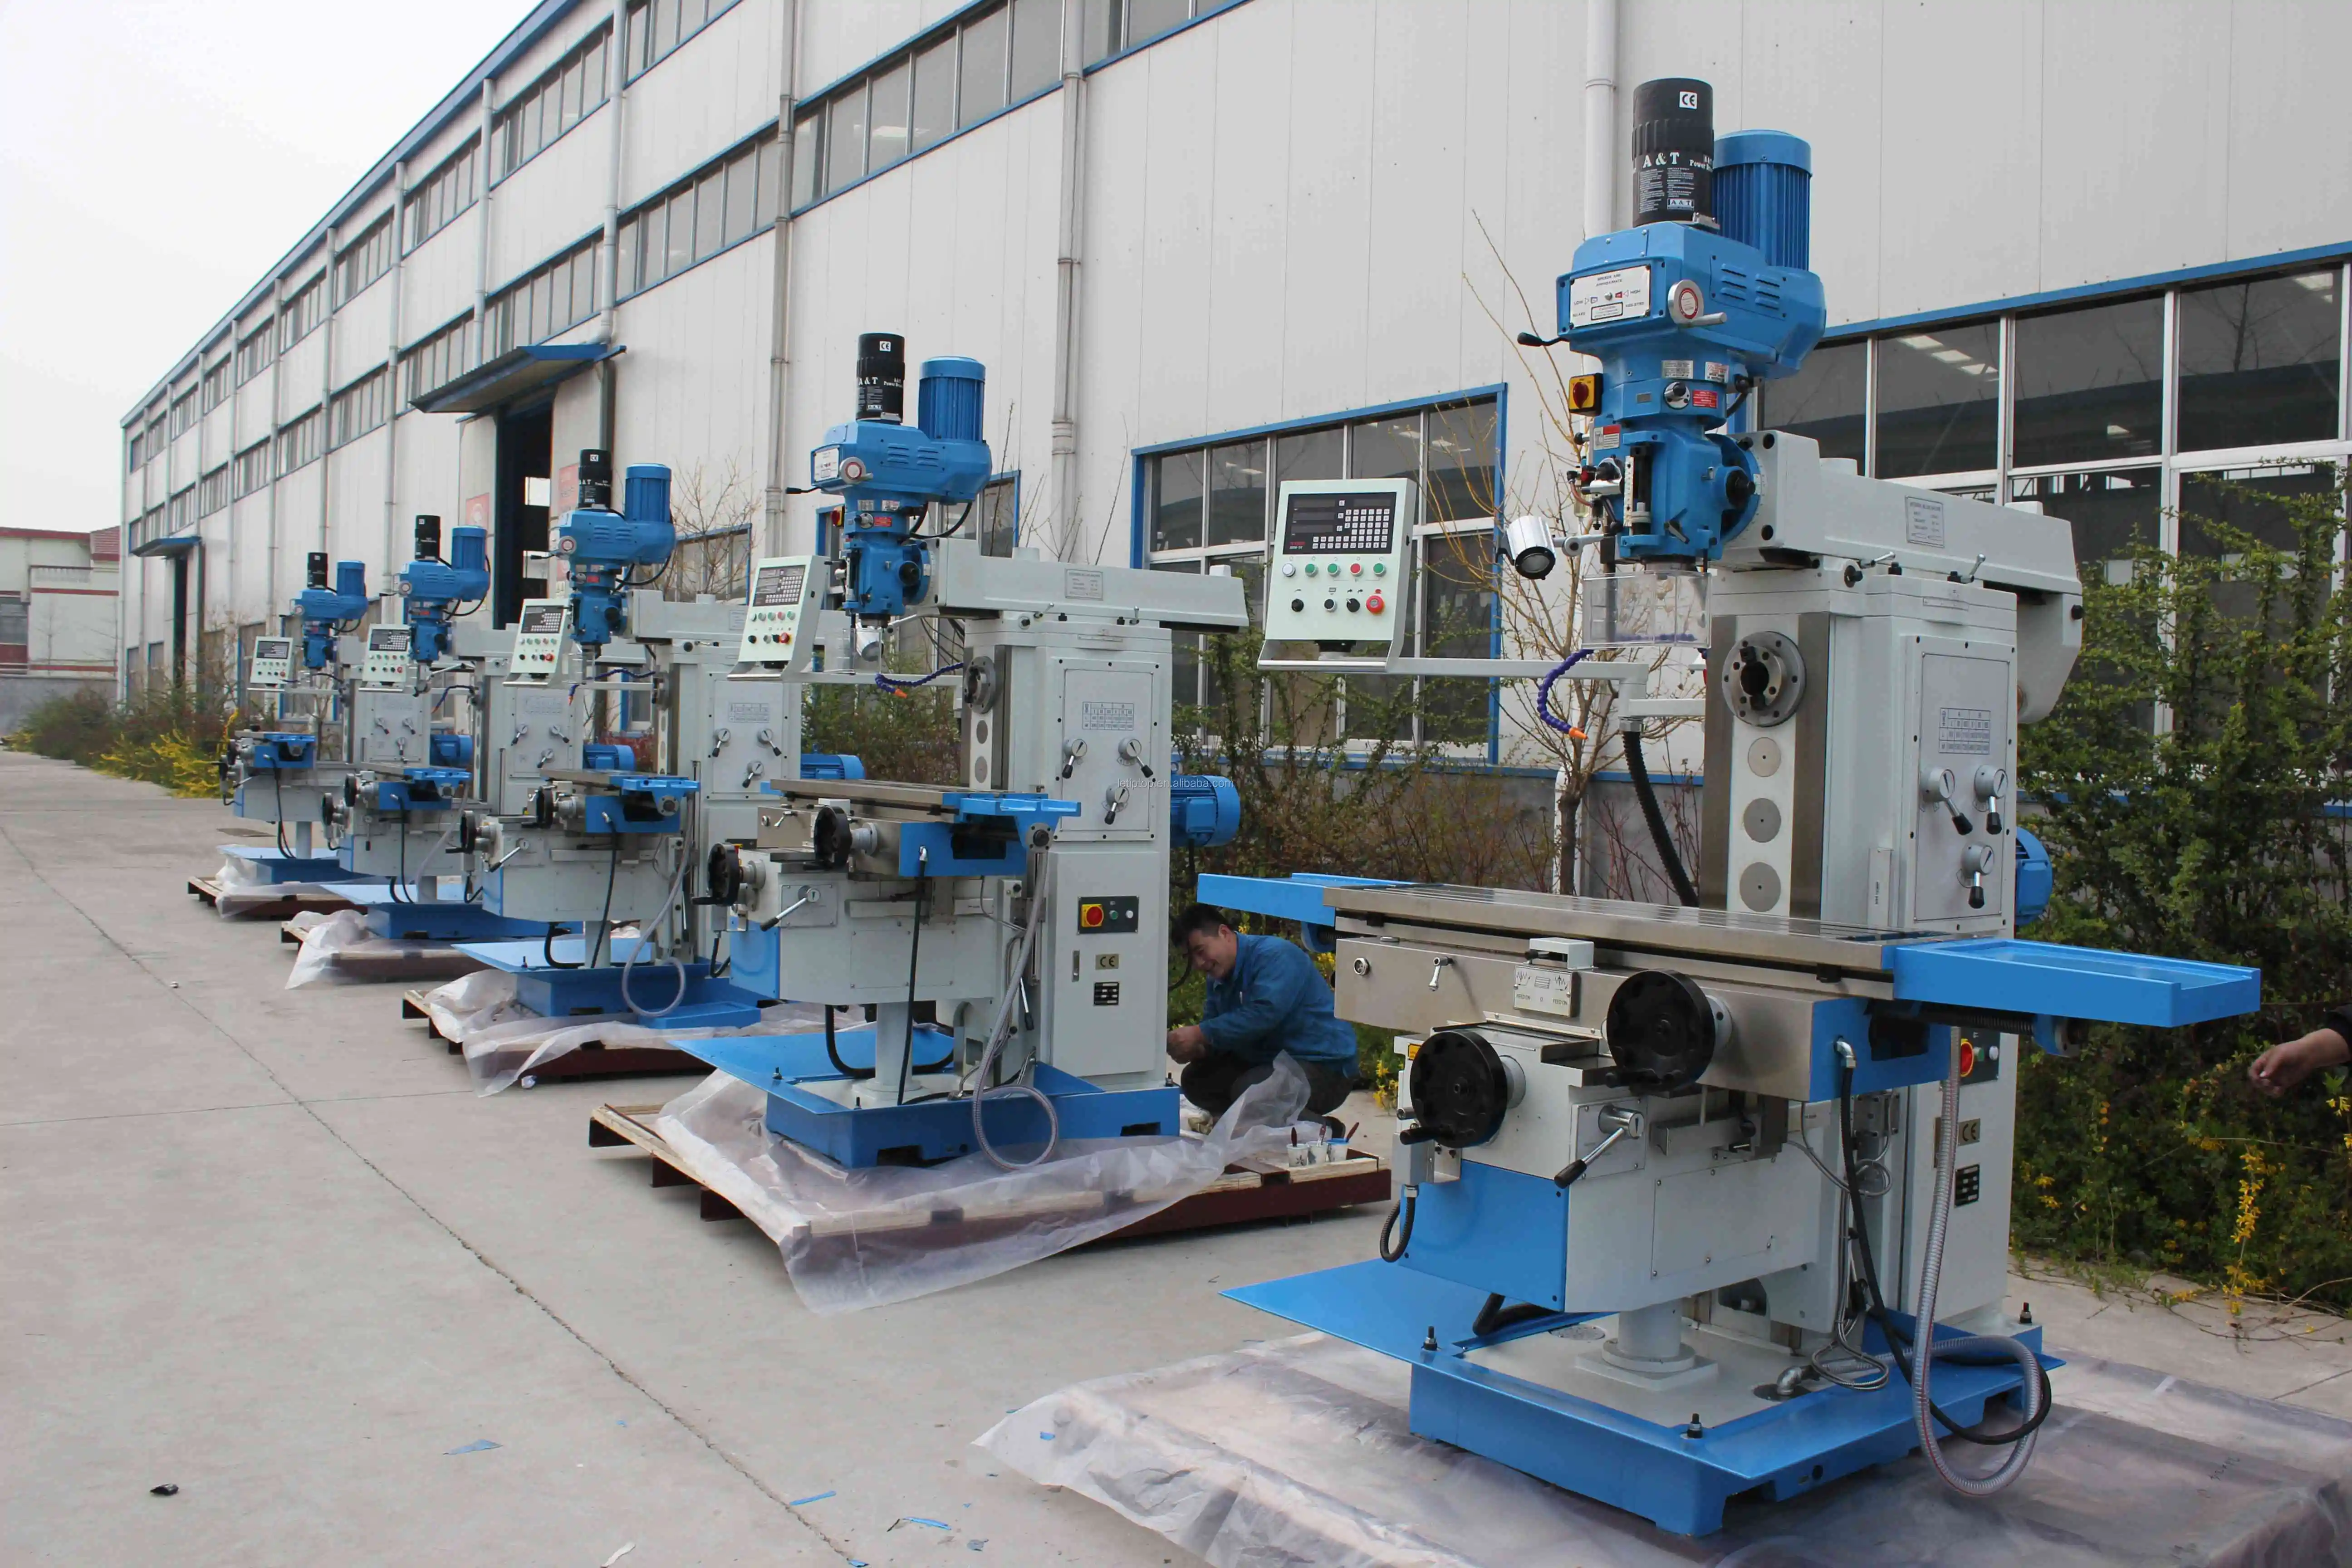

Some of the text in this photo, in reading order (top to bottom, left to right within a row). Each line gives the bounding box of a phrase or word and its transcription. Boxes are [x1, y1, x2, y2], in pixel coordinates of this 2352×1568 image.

[1682, 93, 1695, 106] CE
[1642, 152, 1680, 168] A & T
[1690, 159, 1706, 169] Power
[1100, 956, 1115, 967] CE
[1962, 1122, 1977, 1142] CE
